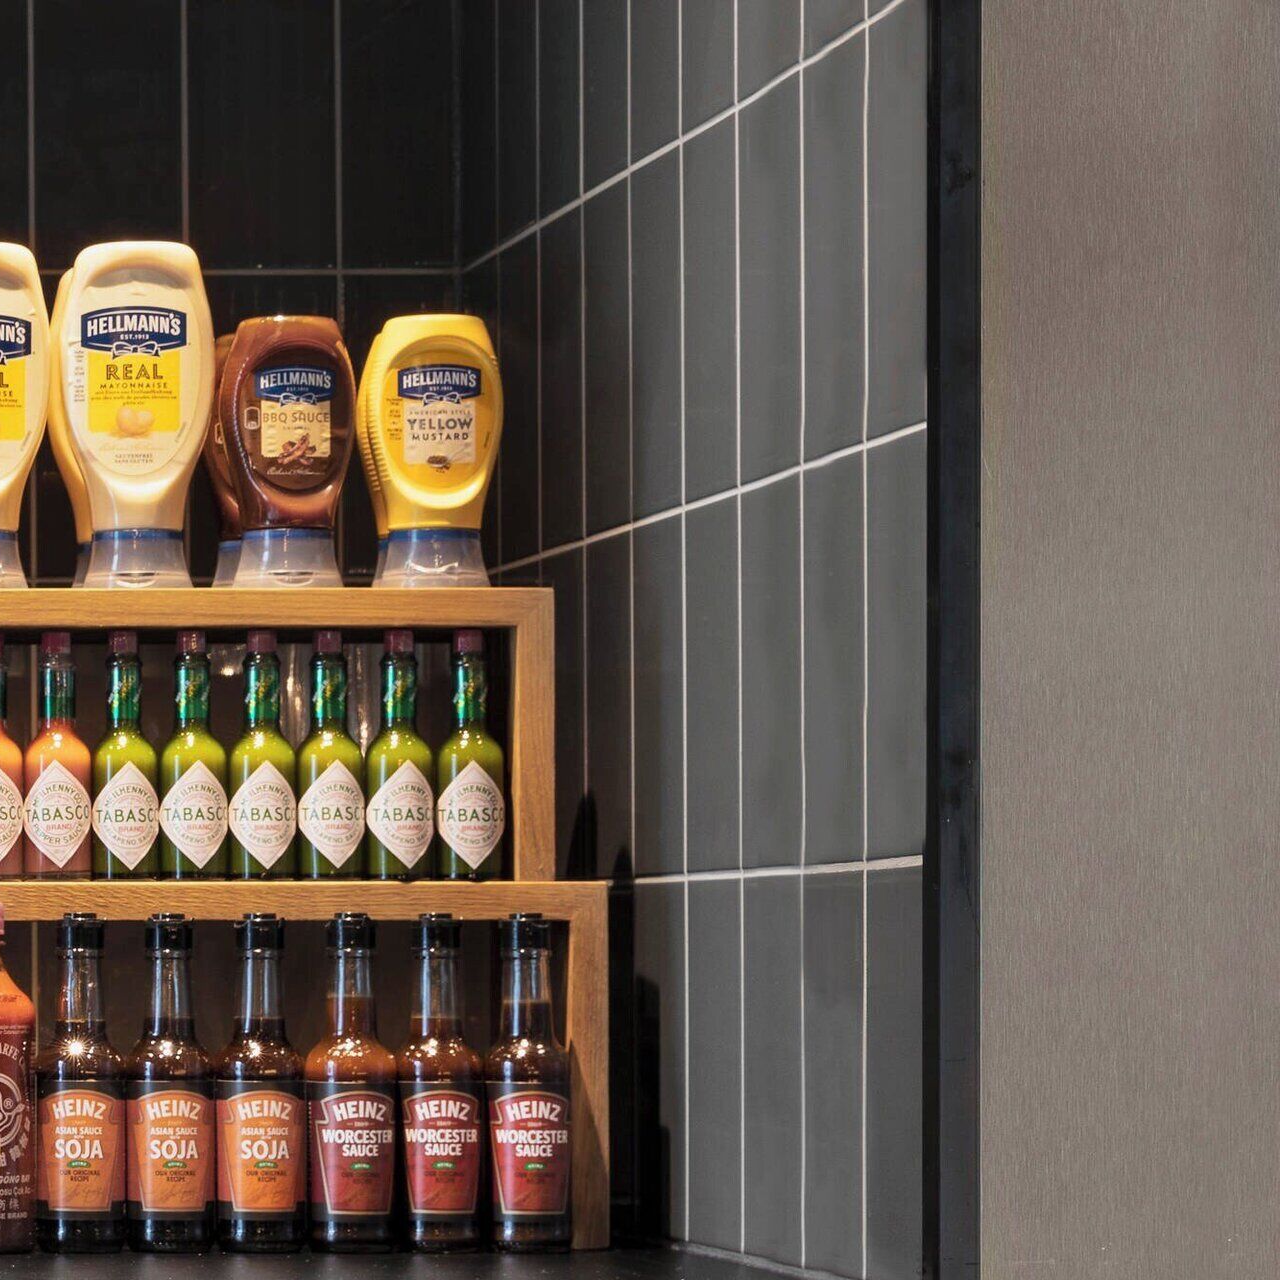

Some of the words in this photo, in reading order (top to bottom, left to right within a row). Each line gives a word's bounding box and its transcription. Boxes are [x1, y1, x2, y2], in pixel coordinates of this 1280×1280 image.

[87, 313, 181, 337] HELLMANN'S
[106, 364, 163, 380] REAL
[260, 371, 331, 389] HELLMANN'S
[403, 370, 476, 388] HELLMANN'S
[263, 412, 287, 423] BBQ
[292, 412, 330, 423] SAUCE
[407, 418, 472, 430] YELLOW
[412, 433, 469, 441] MUSTARD
[26, 805, 89, 822] TABASCO
[373, 807, 433, 821] TABASC
[52, 1099, 106, 1119] HEINZ
[147, 1100, 201, 1120] HEINZ
[238, 1100, 292, 1120] HEINZ
[332, 1100, 386, 1122] HEINZ
[414, 1100, 470, 1121] HEINZ
[505, 1100, 561, 1122] HEINZ
[80, 1127, 103, 1135] SAUCE
[151, 1127, 173, 1135] ASIAN
[241, 1127, 265, 1135] ASIAN
[267, 1127, 289, 1135] SAUCE
[322, 1129, 393, 1143] WORCESTER
[405, 1129, 477, 1143] WORCESTER
[495, 1129, 568, 1144] WORCESTER
[55, 1139, 103, 1159] SOJA
[150, 1139, 198, 1159] SOJA
[241, 1140, 289, 1160] SOJA
[342, 1144, 379, 1157] SAUCE
[424, 1143, 462, 1156] SAUCE
[516, 1145, 552, 1157] SAUCE
